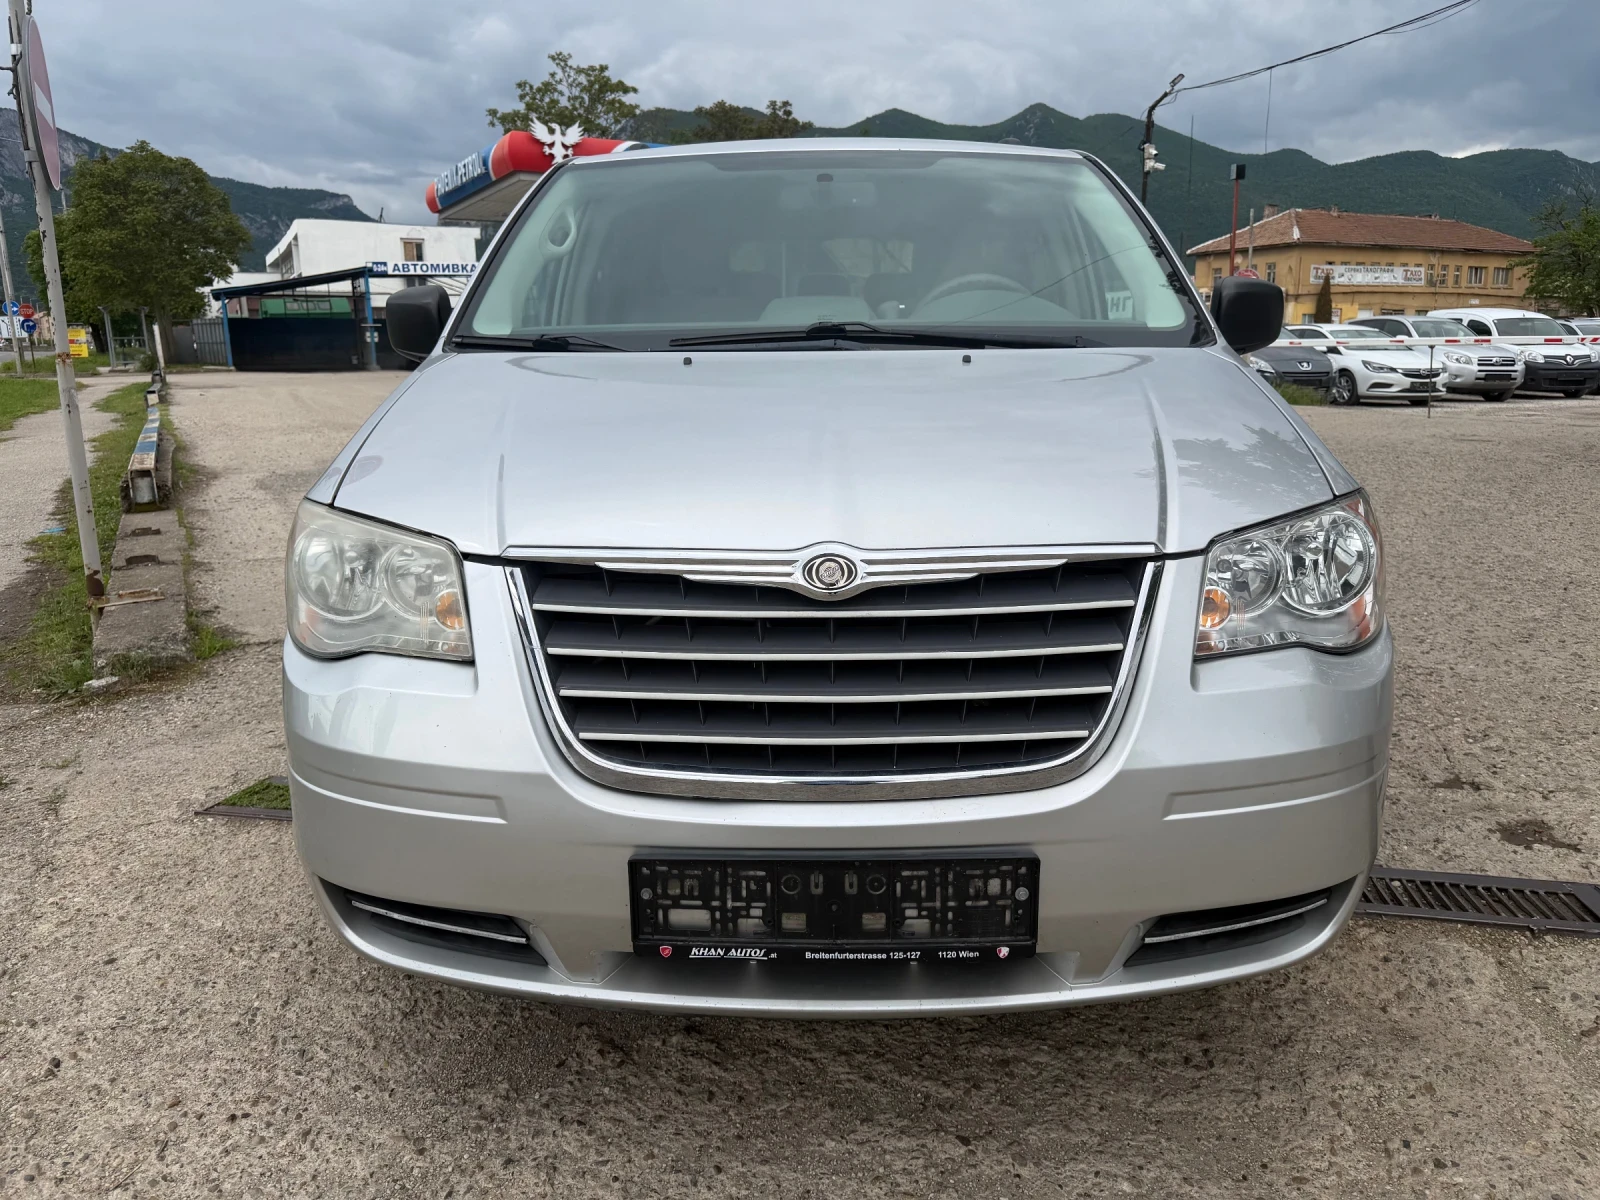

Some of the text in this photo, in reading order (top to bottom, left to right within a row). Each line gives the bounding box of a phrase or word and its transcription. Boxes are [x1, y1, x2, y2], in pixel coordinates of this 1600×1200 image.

[392, 263, 478, 274] АВТОМИВКА
[690, 947, 725, 957] KHAN
[805, 951, 887, 960] Breitenfurterstrasse
[889, 951, 921, 960] 125-127
[958, 950, 980, 958] Wien
